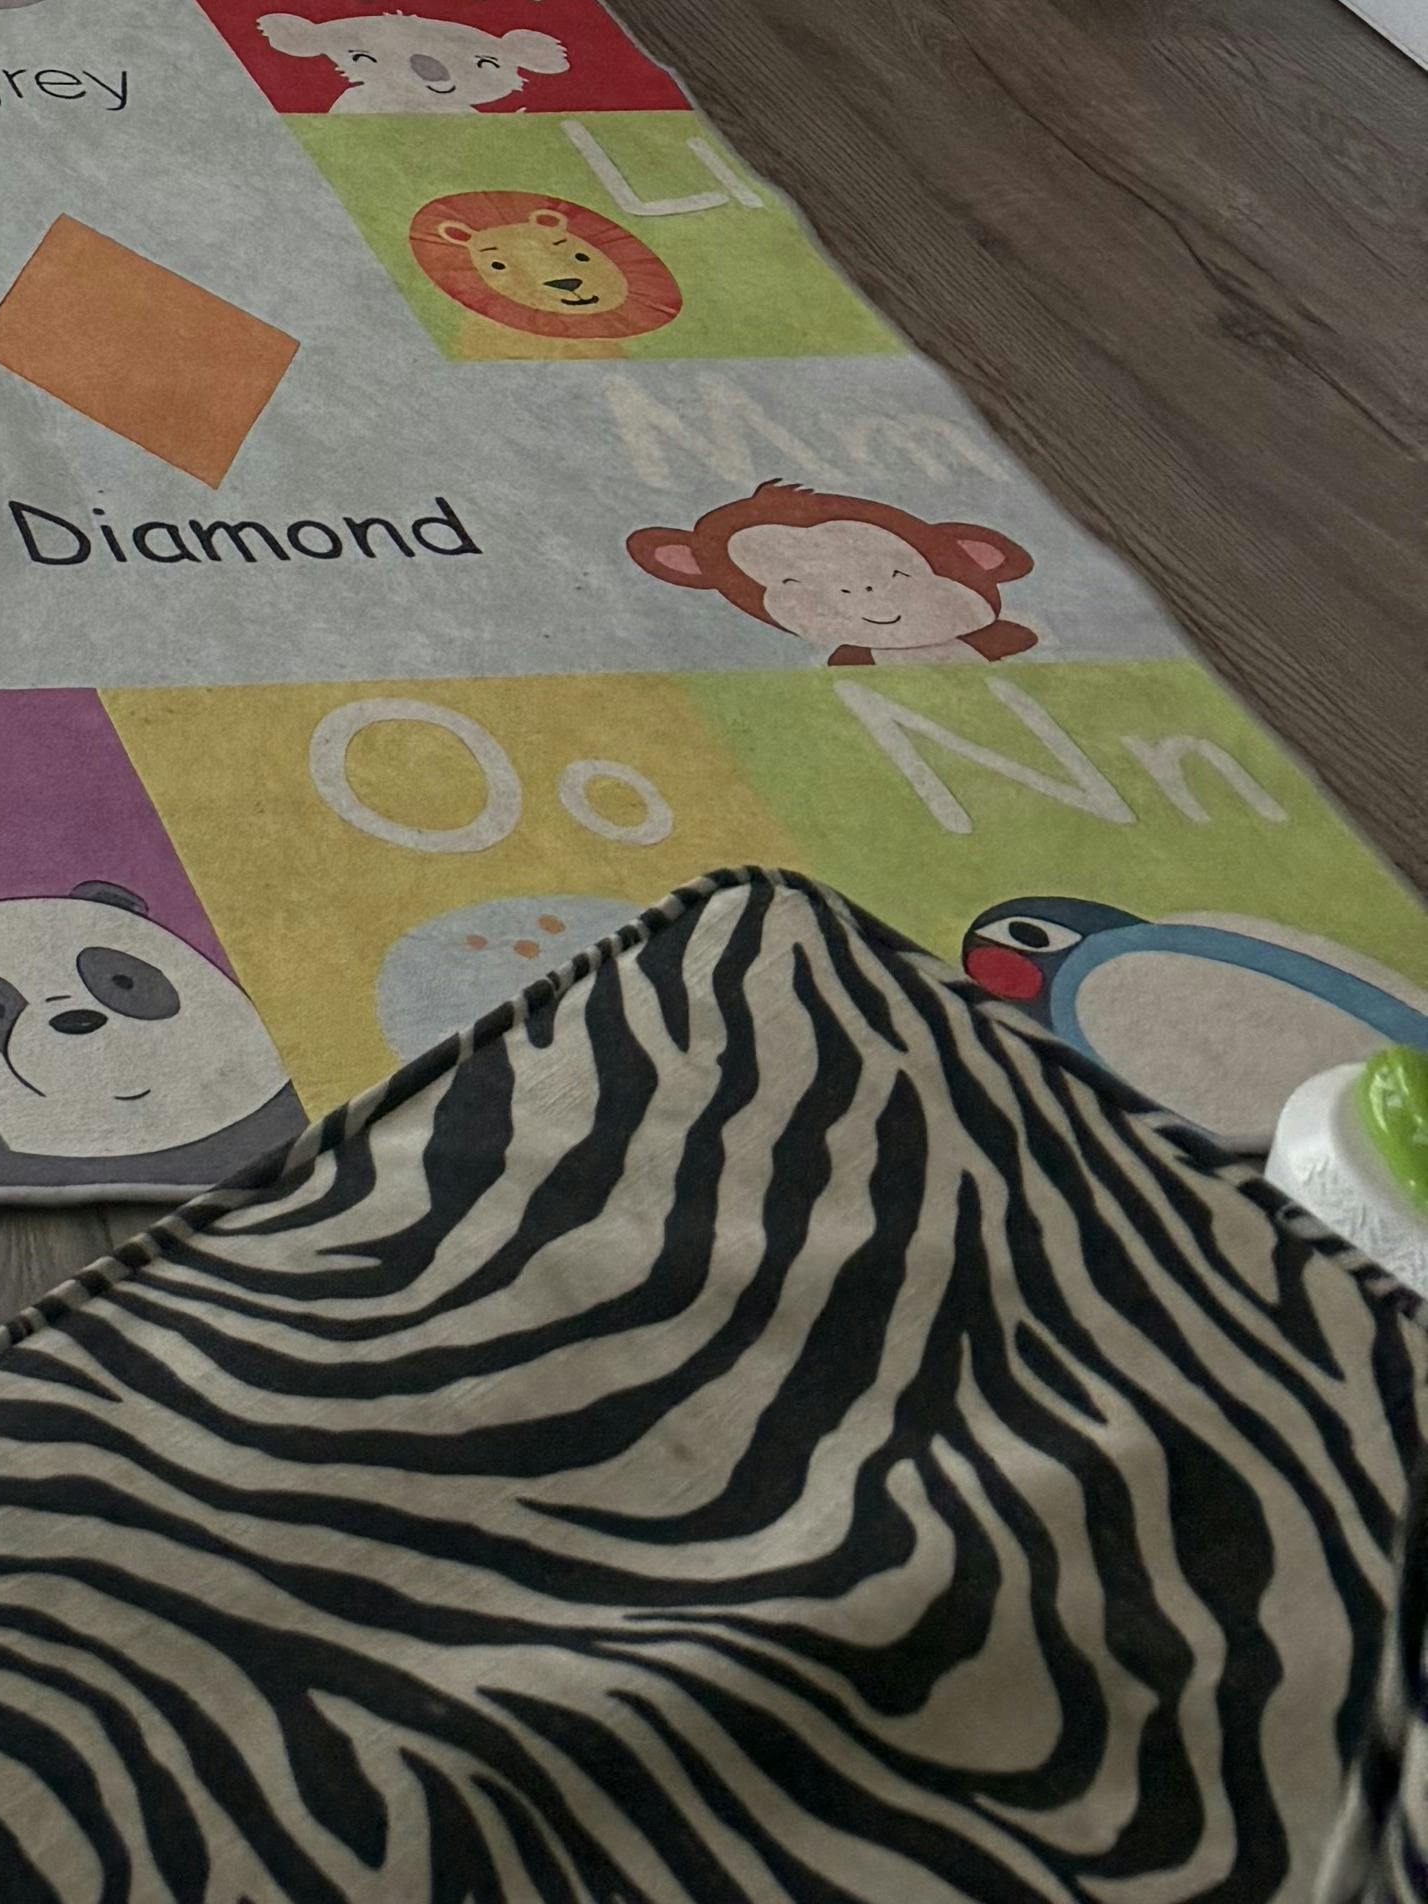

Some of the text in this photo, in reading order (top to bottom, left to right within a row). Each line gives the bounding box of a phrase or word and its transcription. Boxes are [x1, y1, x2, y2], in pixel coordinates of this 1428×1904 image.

[561, 118, 765, 217] Ll
[6, 497, 483, 567] Diamond
[308, 696, 677, 855] Oo
[833, 676, 1290, 837] Nn
